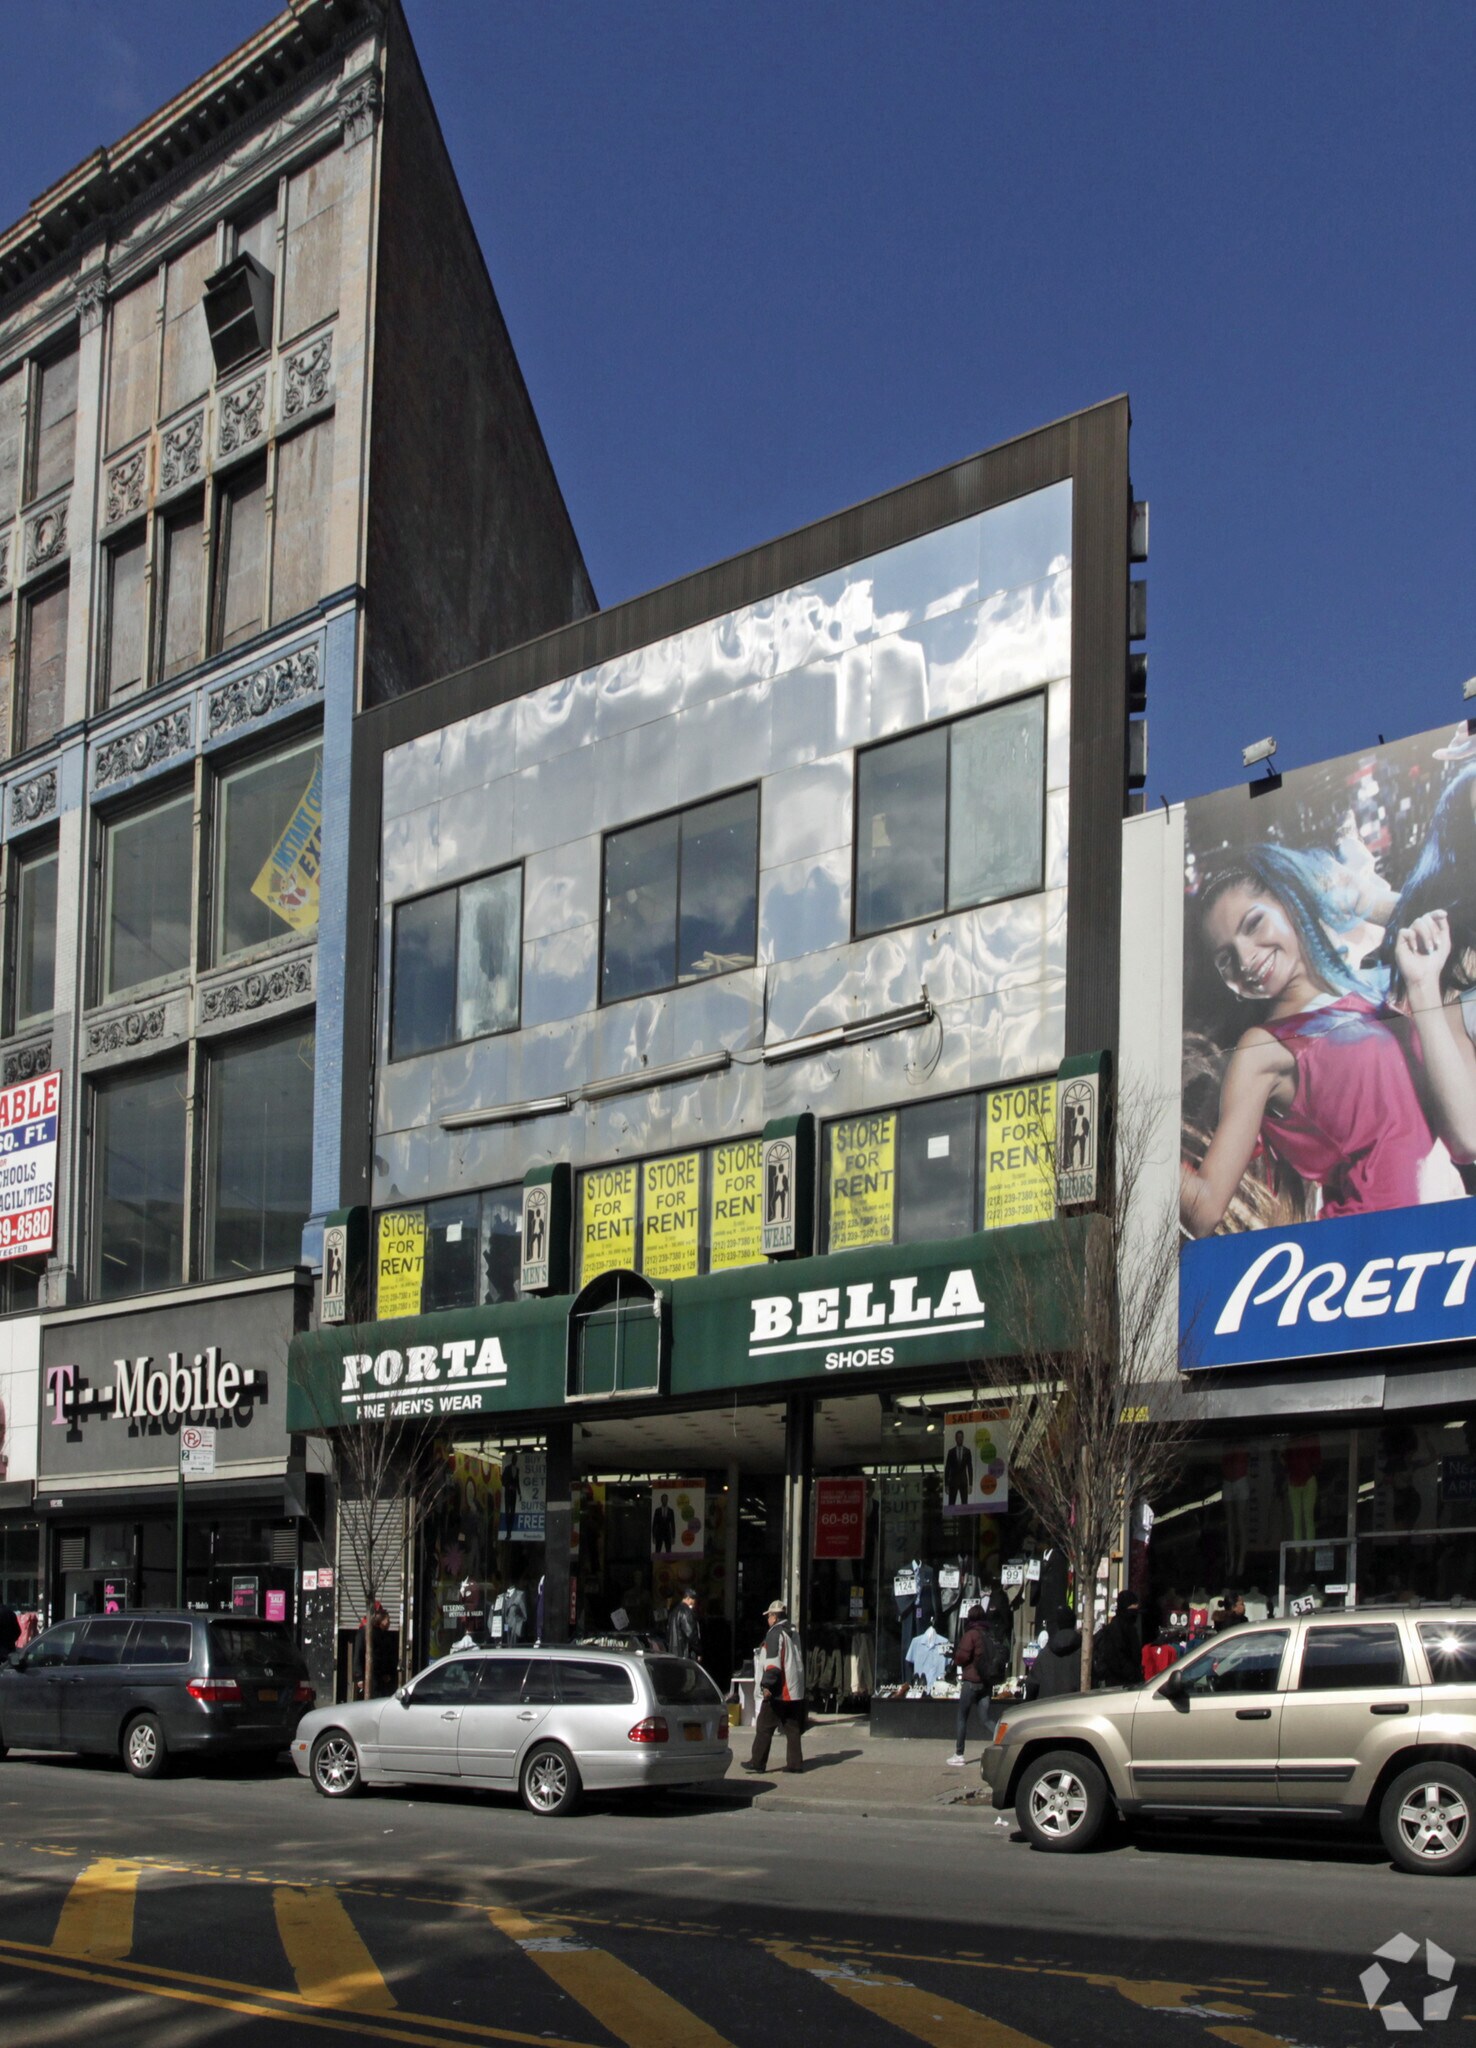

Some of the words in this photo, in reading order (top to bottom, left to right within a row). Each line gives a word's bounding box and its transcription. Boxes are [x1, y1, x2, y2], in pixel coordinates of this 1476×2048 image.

[272, 806, 317, 874] INSTANT
[991, 1085, 1051, 1123] STORE
[24, 1122, 48, 1145] FT.
[836, 1116, 890, 1152] STORE
[1001, 1122, 1039, 1143] FOR
[717, 1142, 762, 1175] STORE
[846, 1151, 879, 1172] FOR
[989, 1141, 1056, 1173] RENT
[0, 1161, 37, 1188] HOOLS
[587, 1168, 631, 1200] STORE
[648, 1158, 695, 1191] STORE
[725, 1174, 756, 1194] FOR
[834, 1169, 894, 1199] RENT
[1059, 1174, 1093, 1199] SHOES
[594, 1200, 621, 1218] FOR
[656, 1191, 686, 1209] FOR
[0, 1209, 50, 1245] 9-8580
[383, 1213, 424, 1237] STORE
[586, 1217, 634, 1243] RENT
[647, 1208, 697, 1235] RENT
[388, 1240, 414, 1253] FOR
[764, 1225, 792, 1249] WEAR
[381, 1256, 424, 1276] RENT
[522, 1264, 547, 1286] MEN'S
[1214, 1241, 1476, 1336] PRETT
[323, 1301, 344, 1318] FINE
[749, 1269, 985, 1342] BELLA
[341, 1336, 507, 1391] PORTA
[825, 1347, 894, 1370] SHOES
[356, 1404, 385, 1420] FINE
[390, 1399, 434, 1417] MEN'S
[440, 1395, 482, 1412] WEAR
[523, 1477, 545, 1487] GET
[532, 1488, 539, 1500] 2
[521, 1501, 545, 1510] SUITS
[517, 1514, 545, 1529] FREE
[821, 1513, 858, 1526] 60-80
